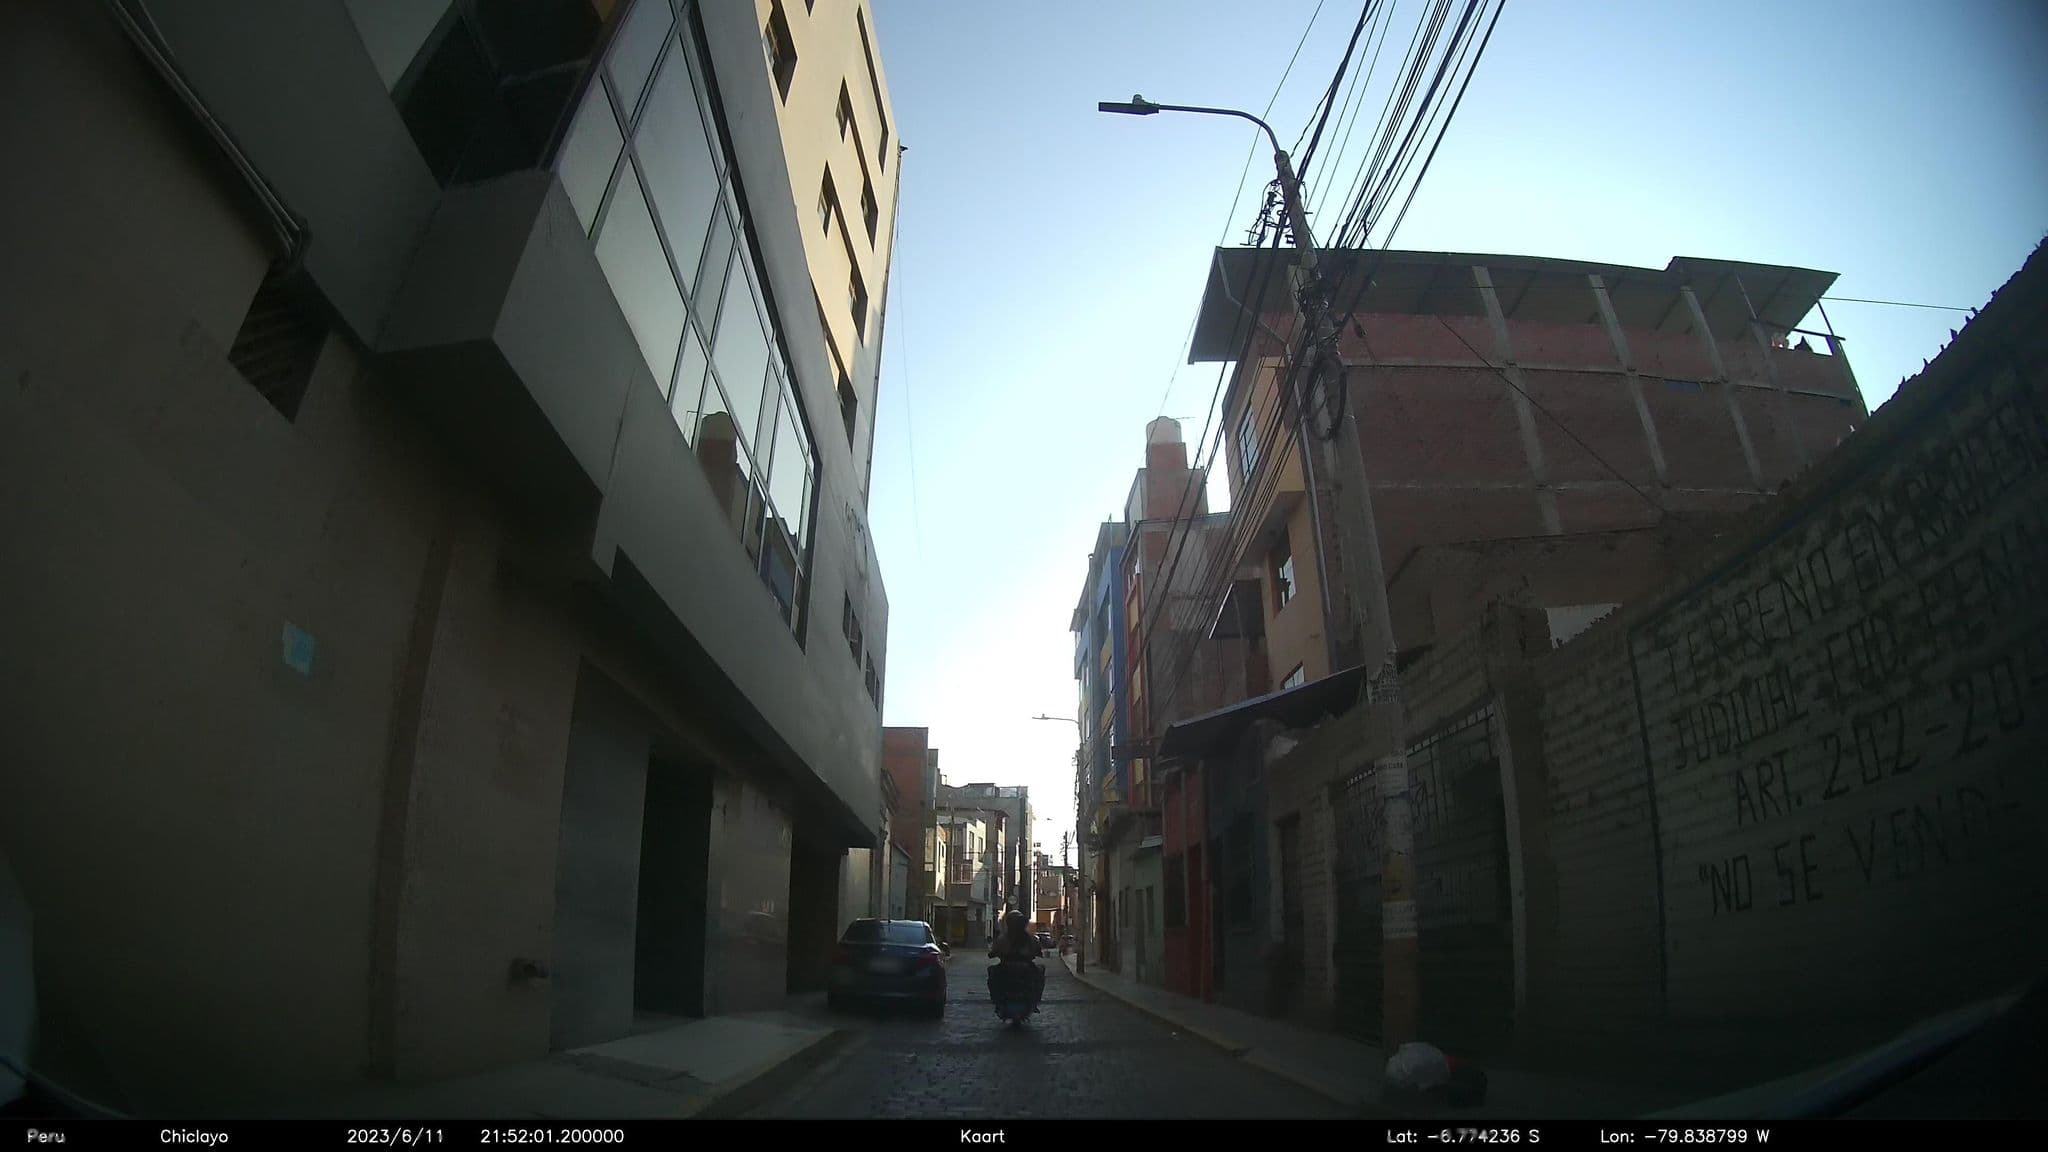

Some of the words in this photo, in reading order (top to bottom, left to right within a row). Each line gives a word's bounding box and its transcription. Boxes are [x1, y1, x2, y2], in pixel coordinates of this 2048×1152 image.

[1658, 546, 1835, 695] TERRENO
[1669, 664, 1810, 771] JUDICIAL
[1735, 747, 1802, 827] ART.
[1773, 831, 1824, 907] SE
